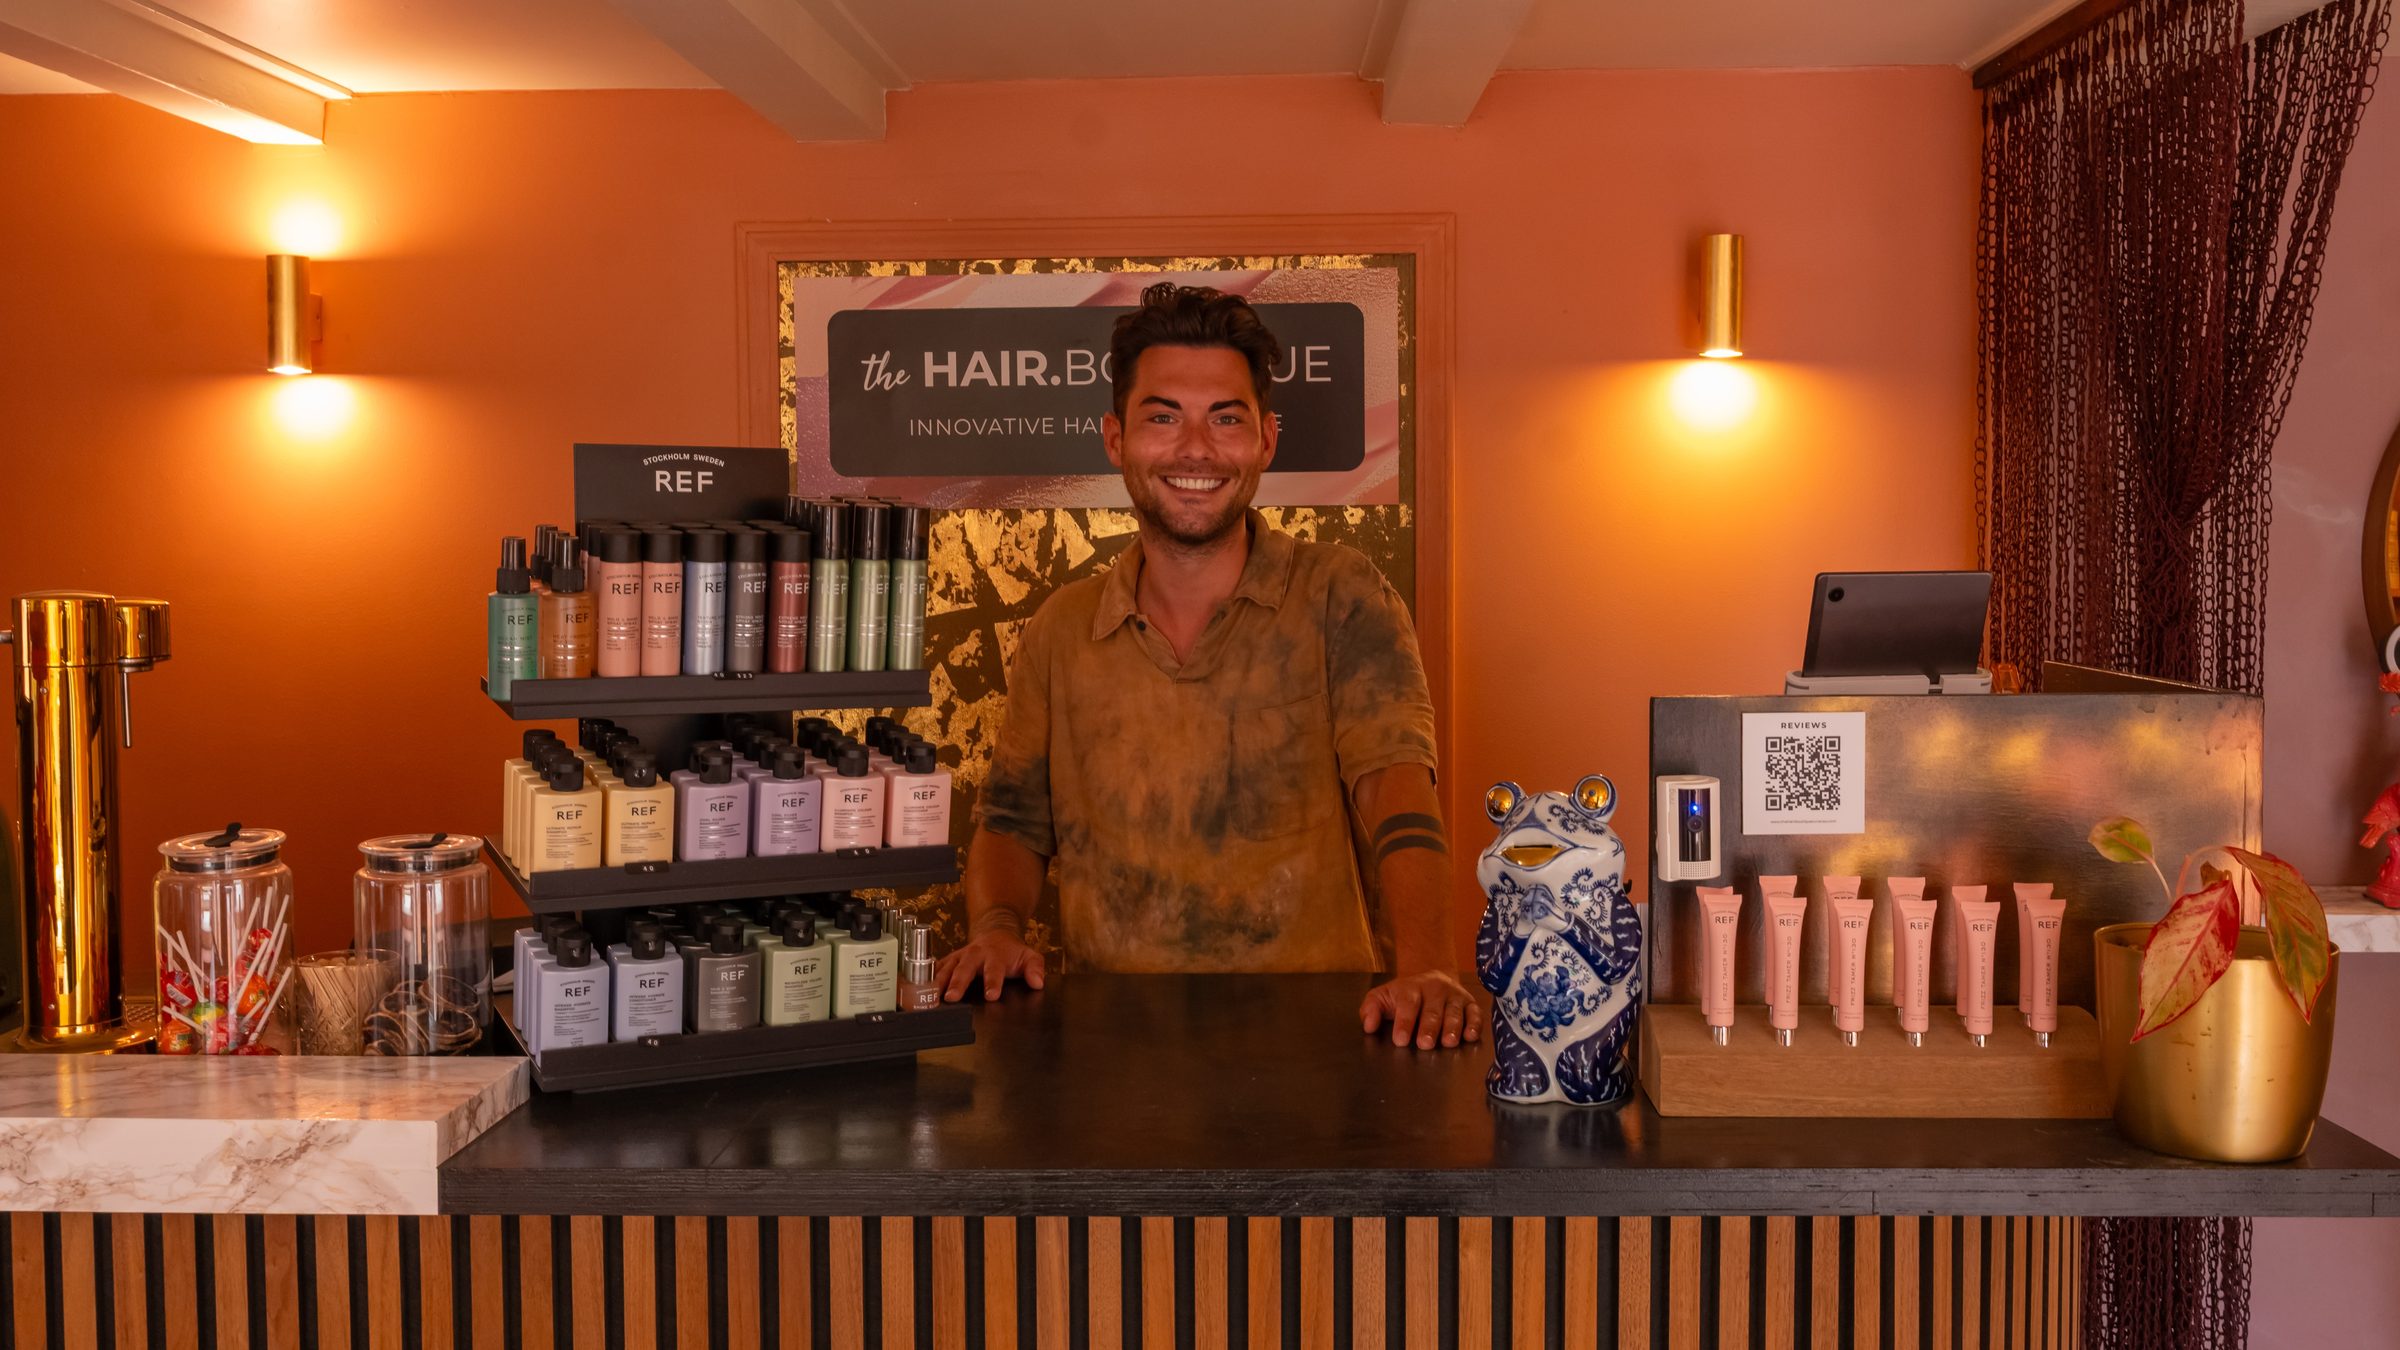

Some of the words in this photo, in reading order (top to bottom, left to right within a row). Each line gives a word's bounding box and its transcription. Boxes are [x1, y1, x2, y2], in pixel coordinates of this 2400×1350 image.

[860, 350, 911, 391] the
[909, 417, 1055, 436] INNOVATIVE
[1064, 416, 1104, 435] HAI
[643, 453, 690, 466] STOCKHOLM
[693, 453, 725, 468] SWEDEN
[655, 470, 713, 493] REF
[612, 583, 640, 595] REF
[653, 582, 681, 594] REF
[784, 582, 809, 595] REF
[507, 614, 535, 626] REF
[565, 613, 590, 625] REF
[1780, 721, 1827, 729] REVIEWS
[844, 793, 868, 803] REF
[913, 790, 936, 800] REF
[710, 801, 734, 812] REF
[782, 797, 806, 808] REF
[556, 810, 583, 820] REF
[631, 806, 657, 816] REF
[1714, 916, 1735, 924] REF
[1779, 919, 1799, 927] REF
[1844, 920, 1864, 929] REF
[2038, 921, 2058, 929] REF
[1910, 922, 1930, 930] REF
[1972, 924, 1993, 932] REF
[860, 958, 883, 968] REF
[794, 963, 817, 975] REF
[721, 969, 745, 981] REF
[639, 978, 665, 989] REF
[565, 986, 591, 998] REF
[920, 993, 938, 1003] REF
